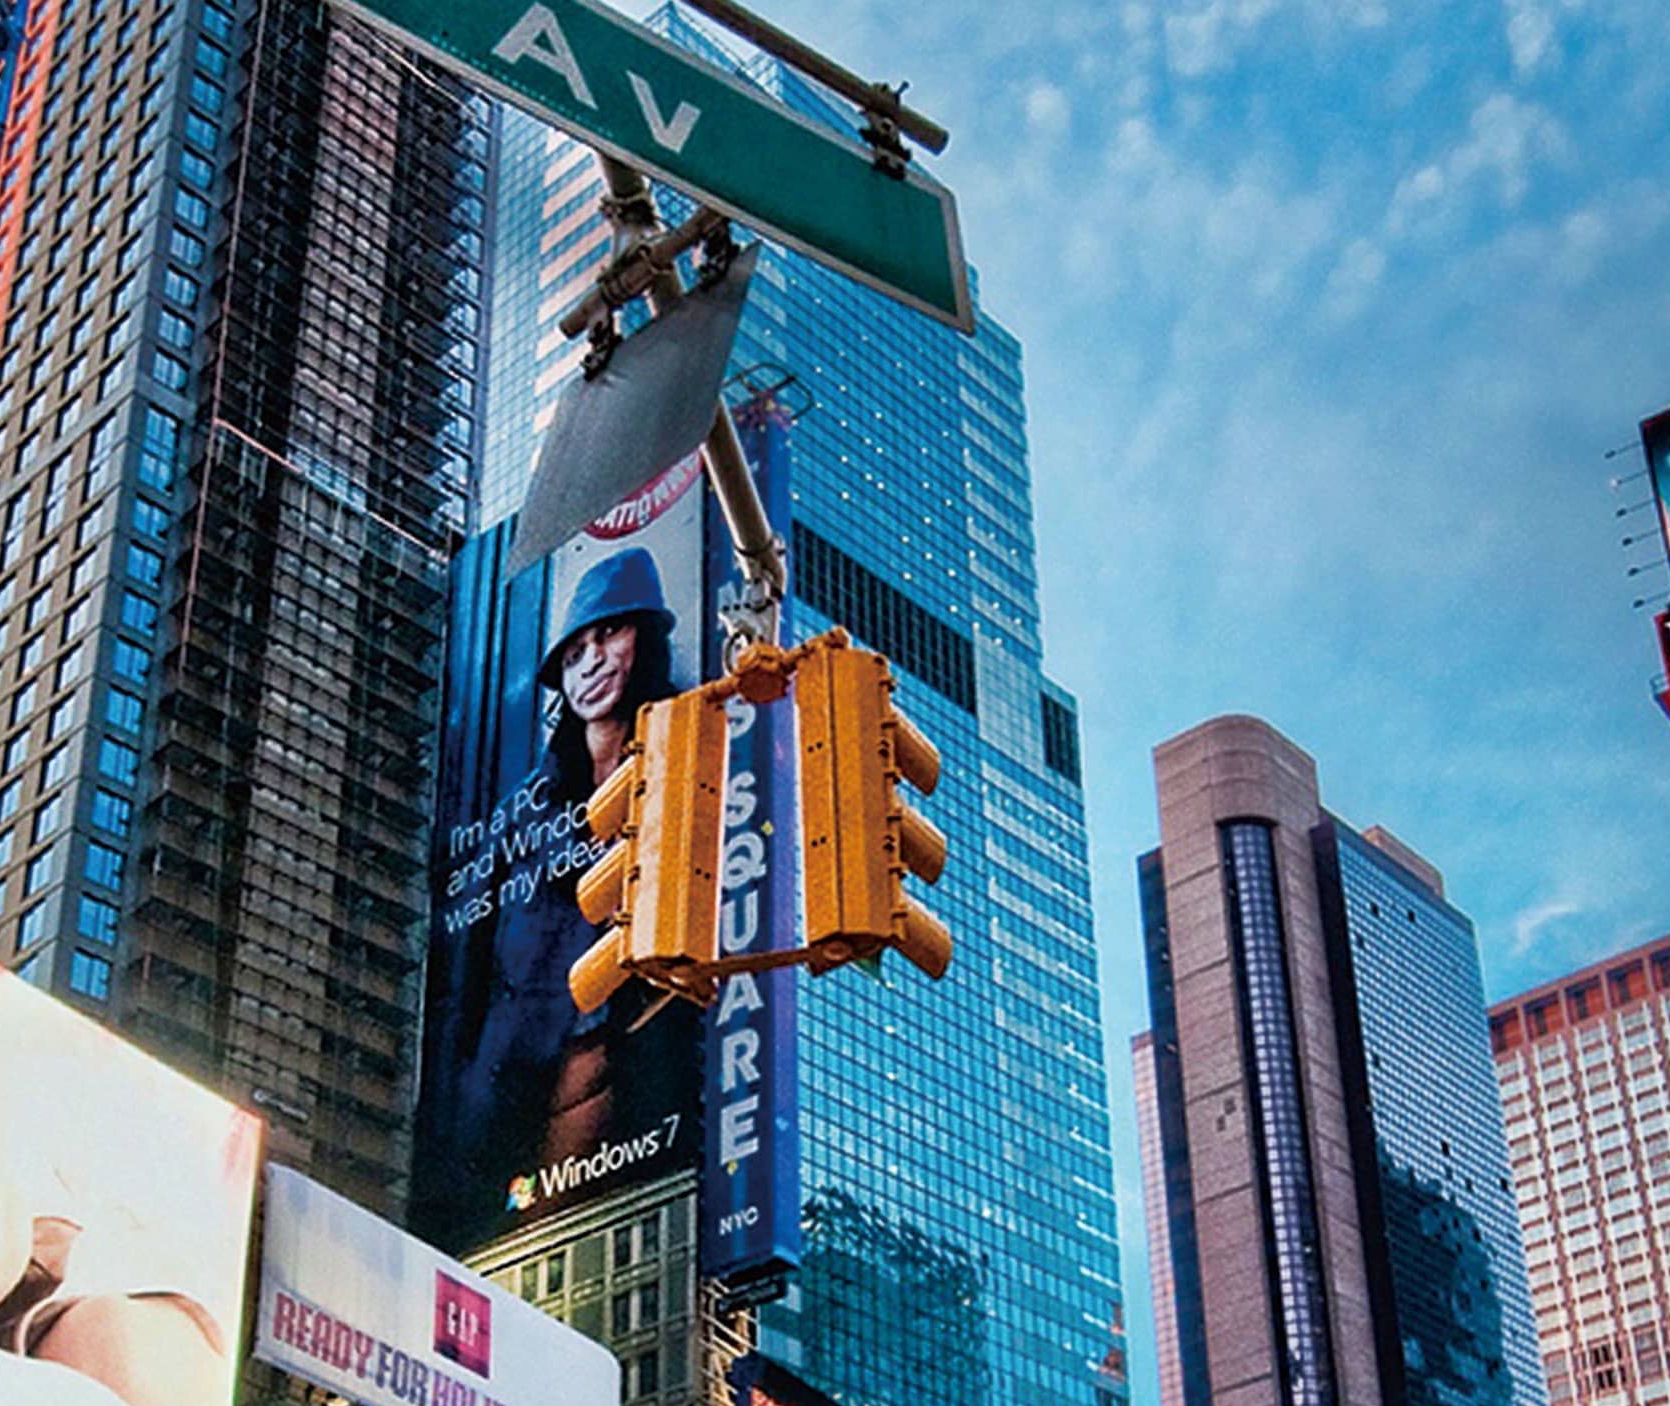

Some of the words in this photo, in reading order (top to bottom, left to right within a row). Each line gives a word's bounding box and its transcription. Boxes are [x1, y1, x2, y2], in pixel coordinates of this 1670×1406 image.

[445, 848, 494, 898] and
[499, 800, 589, 866] Windo
[448, 820, 488, 860] I'm
[491, 807, 510, 832] a
[511, 774, 551, 819] PC
[444, 900, 492, 935] was
[498, 867, 541, 912] my
[545, 835, 610, 882] idea
[717, 770, 770, 1169] SQUARE
[539, 1127, 661, 1199] Windows
[662, 1113, 680, 1148] 7
[719, 1204, 760, 1237] NYC
[273, 1292, 374, 1379] READY
